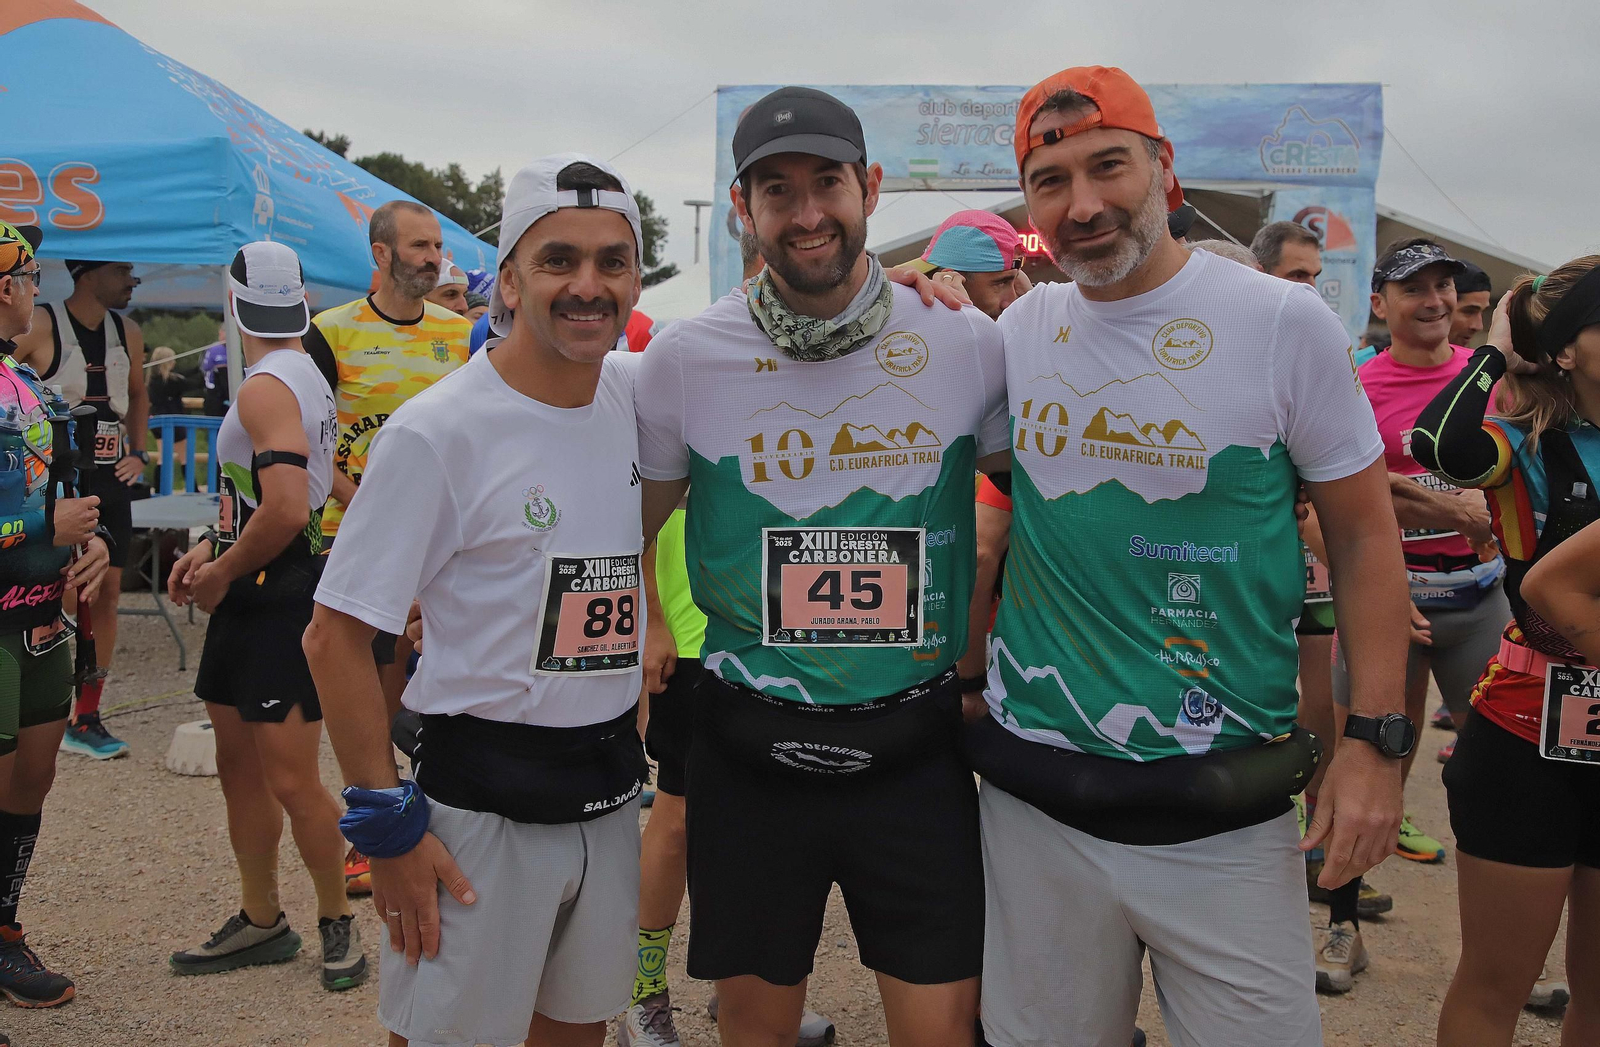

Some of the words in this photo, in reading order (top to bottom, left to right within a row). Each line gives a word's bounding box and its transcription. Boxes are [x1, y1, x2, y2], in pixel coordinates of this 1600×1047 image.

[918, 99, 957, 116] club
[1161, 323, 1175, 338] CLUB
[1176, 321, 1207, 339] DEPORTIVO
[1159, 347, 1187, 366] EURAFRICA
[1188, 347, 1205, 365] TRAIL
[1015, 398, 1069, 457] 10
[745, 429, 815, 483] 10
[829, 459, 848, 472] C.D.
[848, 454, 909, 470] EURAFRICA
[912, 451, 941, 464] TRAIL
[1081, 442, 1098, 458] C.D.
[1100, 445, 1164, 467] EURAFRICA
[1168, 453, 1206, 470] TRAIL
[800, 532, 838, 549] XIII
[840, 532, 888, 541] EDICIÓN
[840, 540, 889, 550] CRESTA
[1129, 534, 1239, 562] Sumitecni
[789, 550, 900, 563] CARBONERA
[582, 558, 610, 578] XIII
[611, 567, 636, 576] CRESTA
[807, 570, 884, 610] 45
[583, 595, 635, 639] 88
[811, 617, 836, 625] JURADO
[861, 617, 880, 625] PABLO
[1151, 606, 1218, 620] FARMACIA
[798, 705, 835, 713] HANKER
[583, 778, 641, 812] SALOMON
